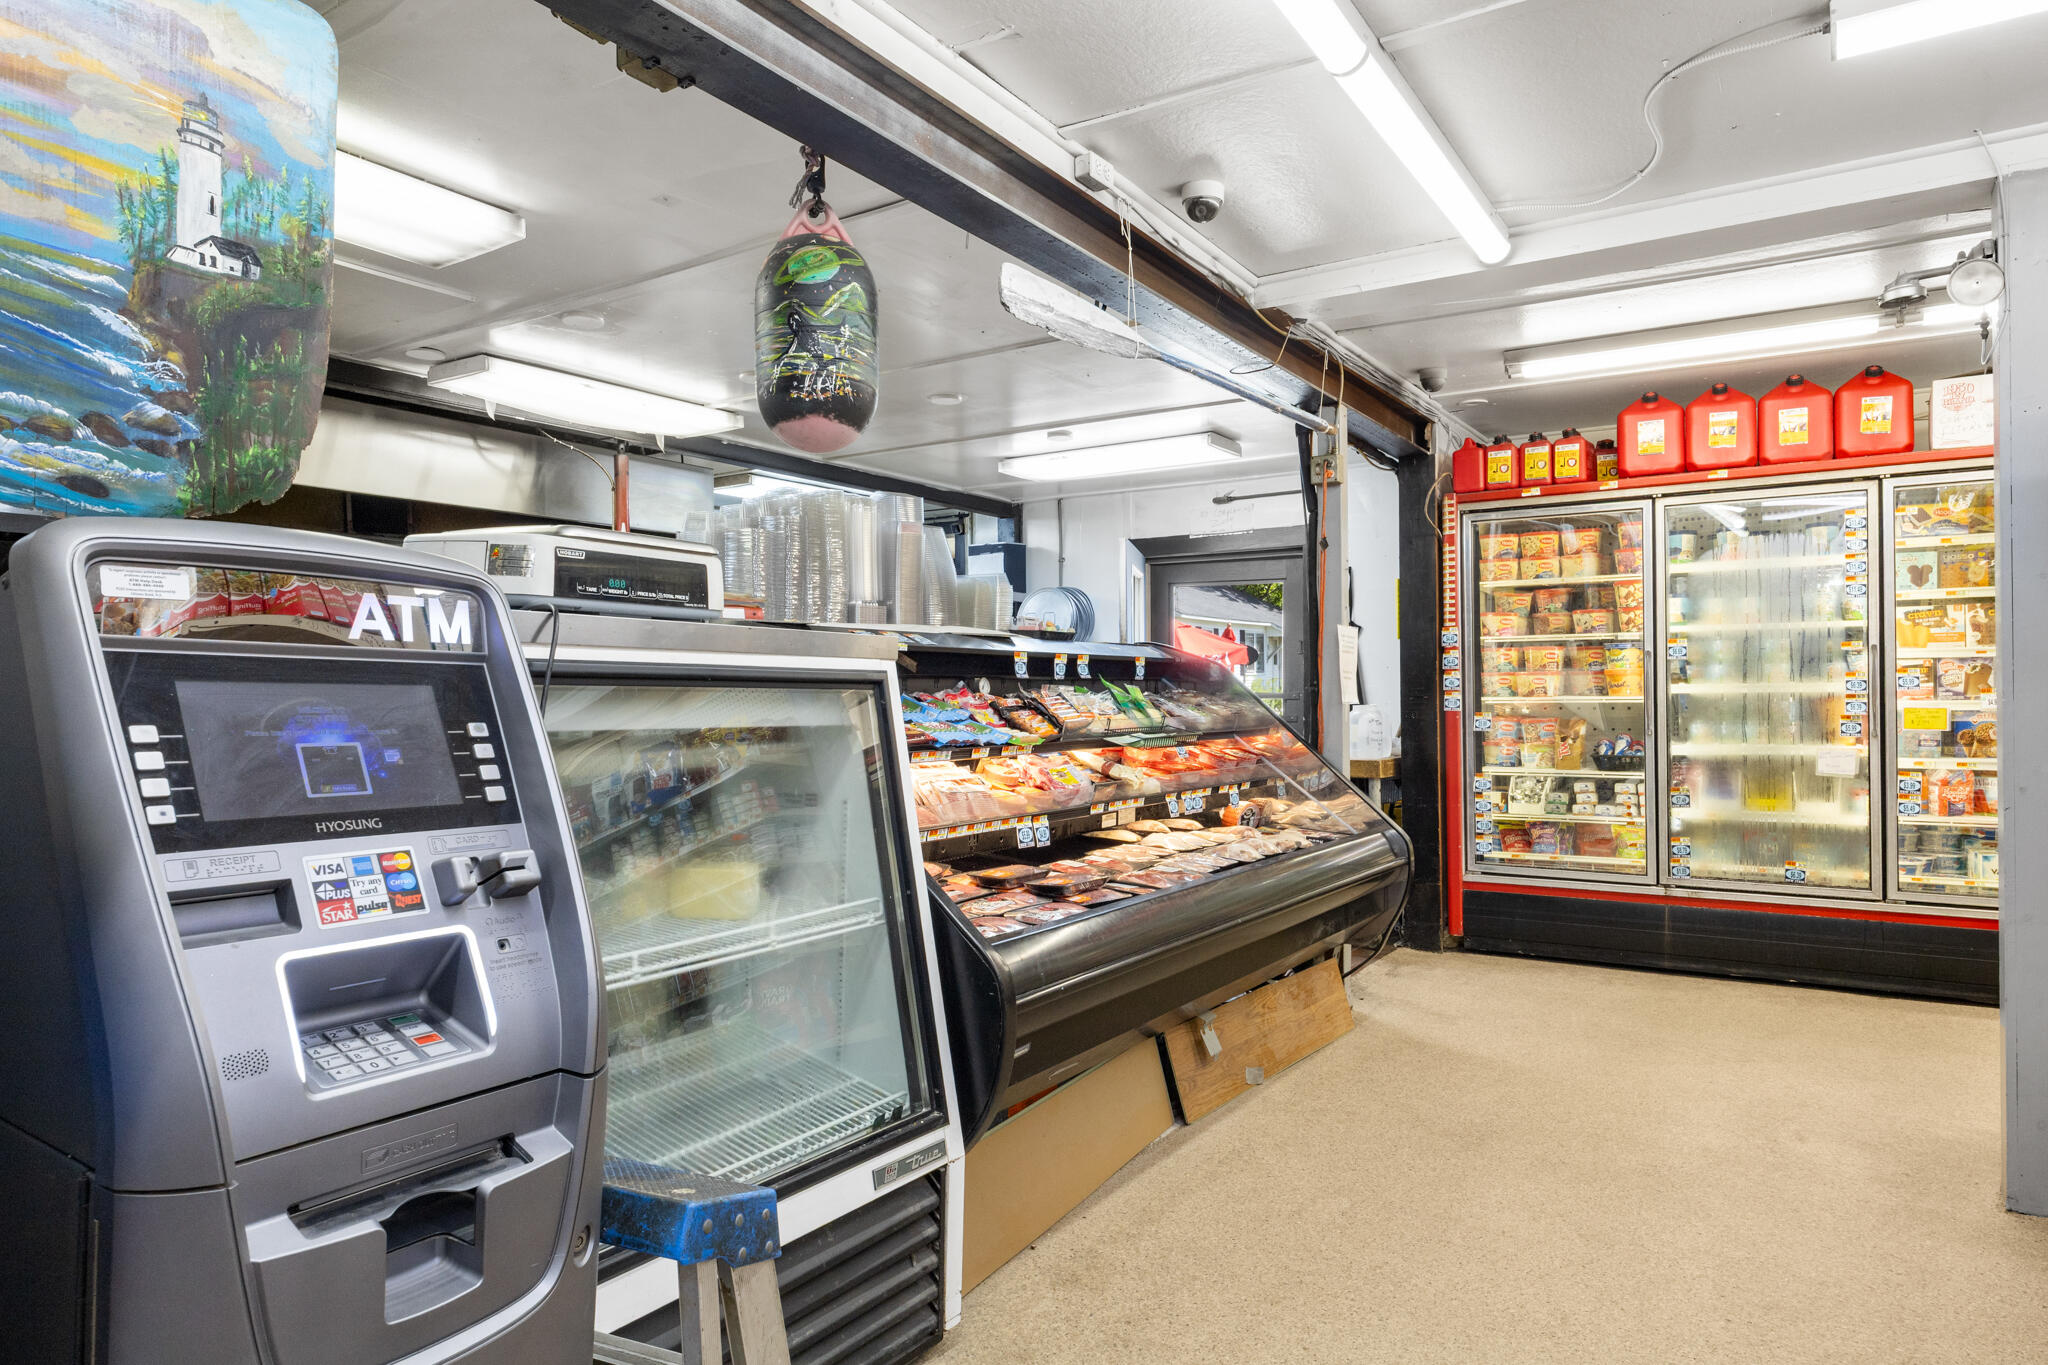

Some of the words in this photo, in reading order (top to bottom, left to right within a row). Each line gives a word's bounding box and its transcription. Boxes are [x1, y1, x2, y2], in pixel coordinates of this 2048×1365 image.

[348, 592, 472, 645] ATM
[315, 817, 383, 833] HYOSUNG
[209, 855, 256, 867] RECEIPT
[311, 863, 345, 876] VISA
[351, 879, 366, 888] Try
[368, 878, 382, 886] any
[326, 888, 351, 900] PLUS
[359, 886, 378, 895] card
[356, 900, 388, 914] pulse
[321, 909, 355, 924] STAR
